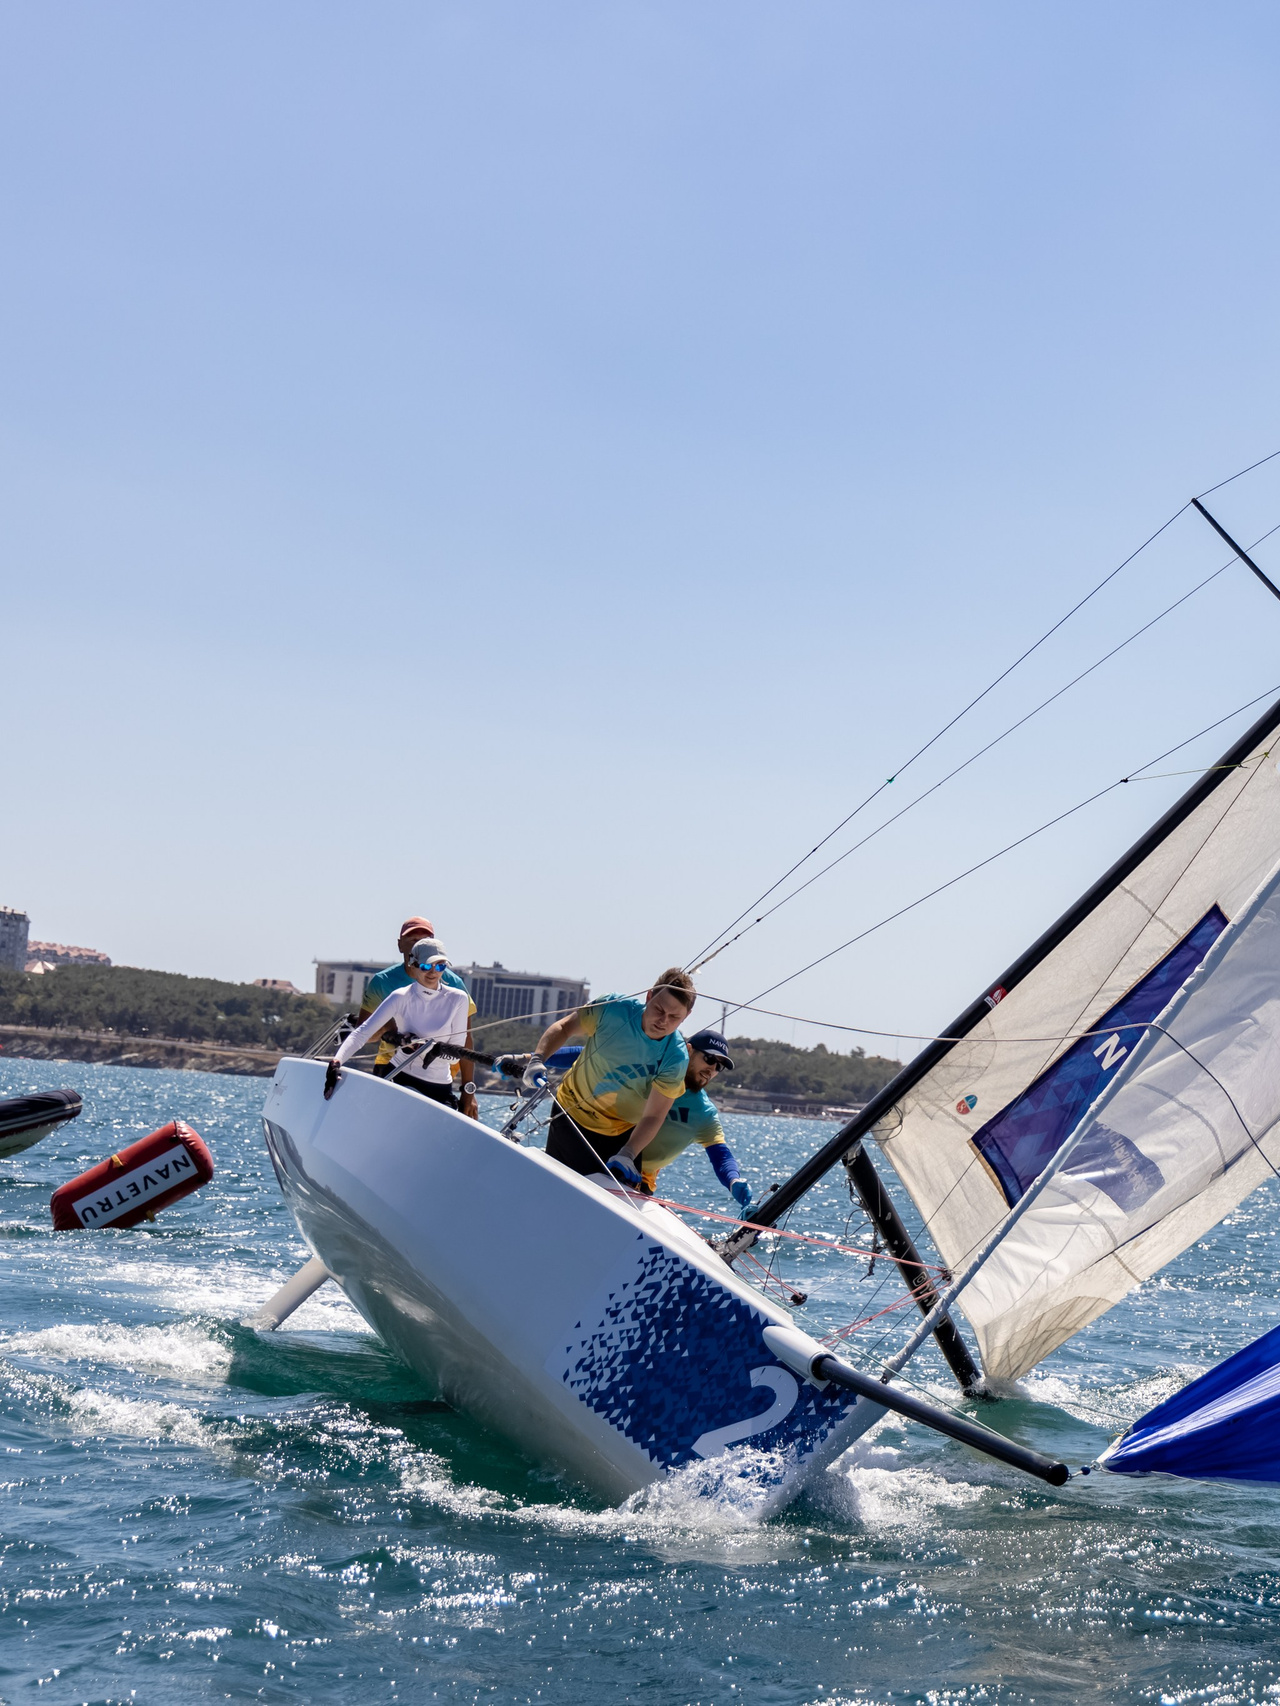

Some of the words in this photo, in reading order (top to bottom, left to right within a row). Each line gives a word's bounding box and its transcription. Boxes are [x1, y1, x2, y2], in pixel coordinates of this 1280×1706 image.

[709, 1038, 729, 1054] NAVE
[81, 1155, 191, 1223] NAVETRU
[691, 1366, 798, 1461] 2
